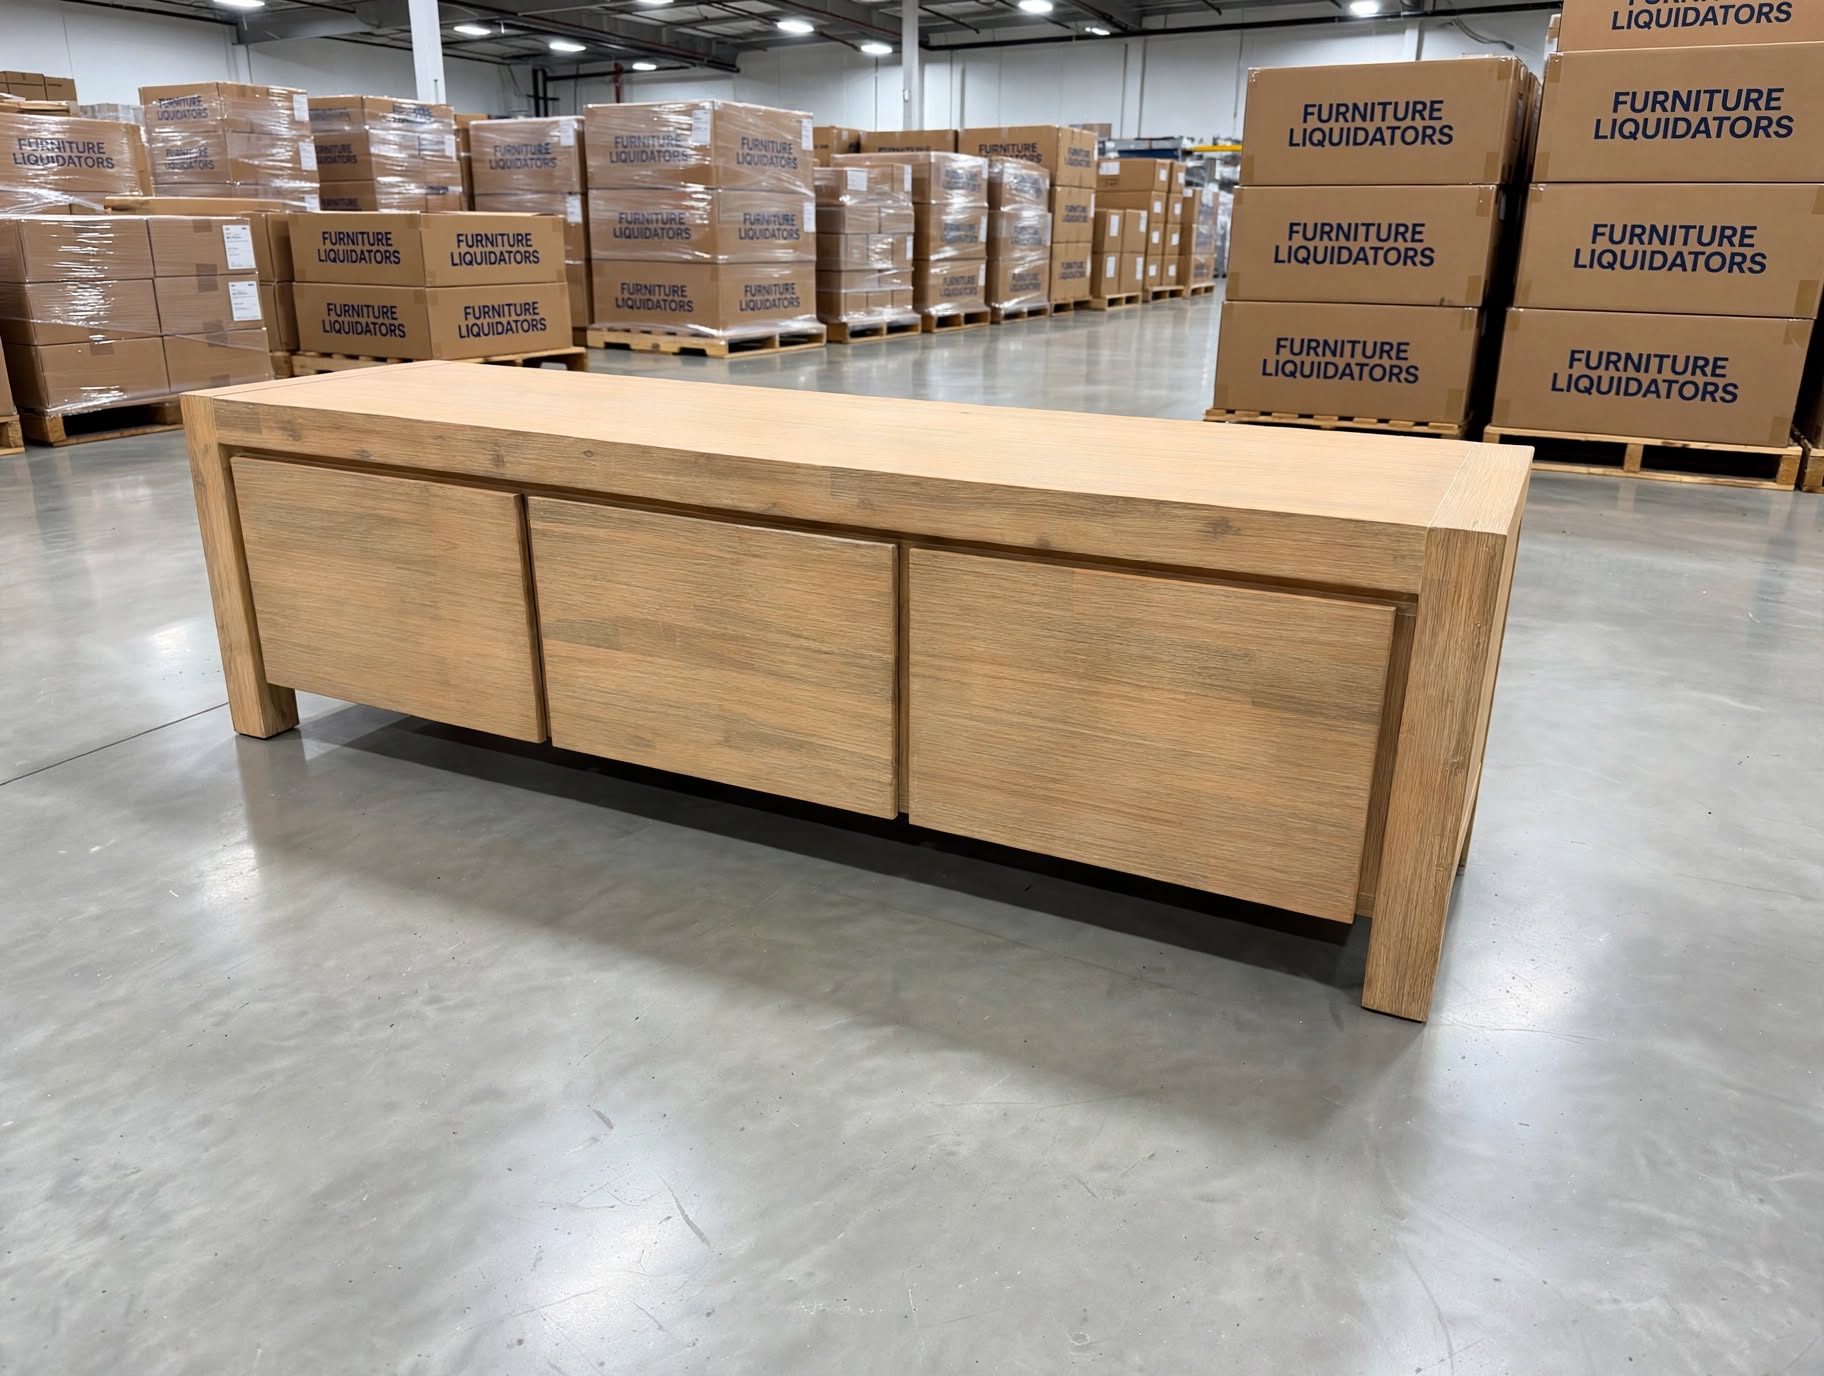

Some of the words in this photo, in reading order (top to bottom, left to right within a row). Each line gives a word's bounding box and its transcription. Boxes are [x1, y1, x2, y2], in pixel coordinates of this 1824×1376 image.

[1611, 2, 1793, 30] LIQUIDATORS
[1612, 88, 1785, 113] FURNITURE
[157, 108, 208, 120] LIQUIDATORS
[1303, 100, 1444, 123] FURNITURE
[1288, 124, 1454, 147] LIQUIDATORS
[1593, 115, 1794, 142] LIQUIDATORS
[18, 138, 106, 155] FURNITURE
[493, 143, 553, 155] FURNITURE
[614, 135, 682, 148] FURNITURE
[741, 136, 793, 154] FURNITURE
[978, 142, 1038, 154] FURNITURE
[13, 152, 115, 169] LIQUIDATORS
[489, 157, 558, 169] LIQUIDATORS
[610, 149, 688, 163] LIQUIDATORS
[736, 152, 798, 169] LIQUIDATORS
[618, 212, 686, 225] FURNITURE
[743, 212, 796, 227] FURNITURE
[322, 231, 393, 247] FURNITURE
[456, 233, 533, 249] FURNITURE
[613, 227, 692, 240] LIQUIDATORS
[739, 225, 800, 240] LIQUIDATORS
[1288, 222, 1425, 243] FURNITURE
[1591, 224, 1757, 248] FURNITURE
[317, 249, 401, 265] LIQUIDATORS
[450, 250, 540, 266] LIQUIDATORS
[1274, 245, 1435, 267] LIQUIDATORS
[1573, 249, 1767, 274] LIQUIDATORS
[621, 282, 688, 298] FURNITURE
[744, 283, 796, 297] FURNITURE
[327, 303, 398, 320] FURNITURE
[464, 301, 540, 321] FURNITURE
[615, 297, 694, 312] LIQUIDATORS
[740, 297, 800, 312] LIQUIDATORS
[322, 319, 406, 338] LIQUIDATORS
[458, 317, 547, 338] LIQUIDATORS
[1275, 337, 1410, 361] FURNITURE
[1262, 359, 1420, 384] LIQUIDATORS
[1568, 350, 1729, 378] FURNITURE
[1551, 372, 1738, 404] LIQUIDATORS
